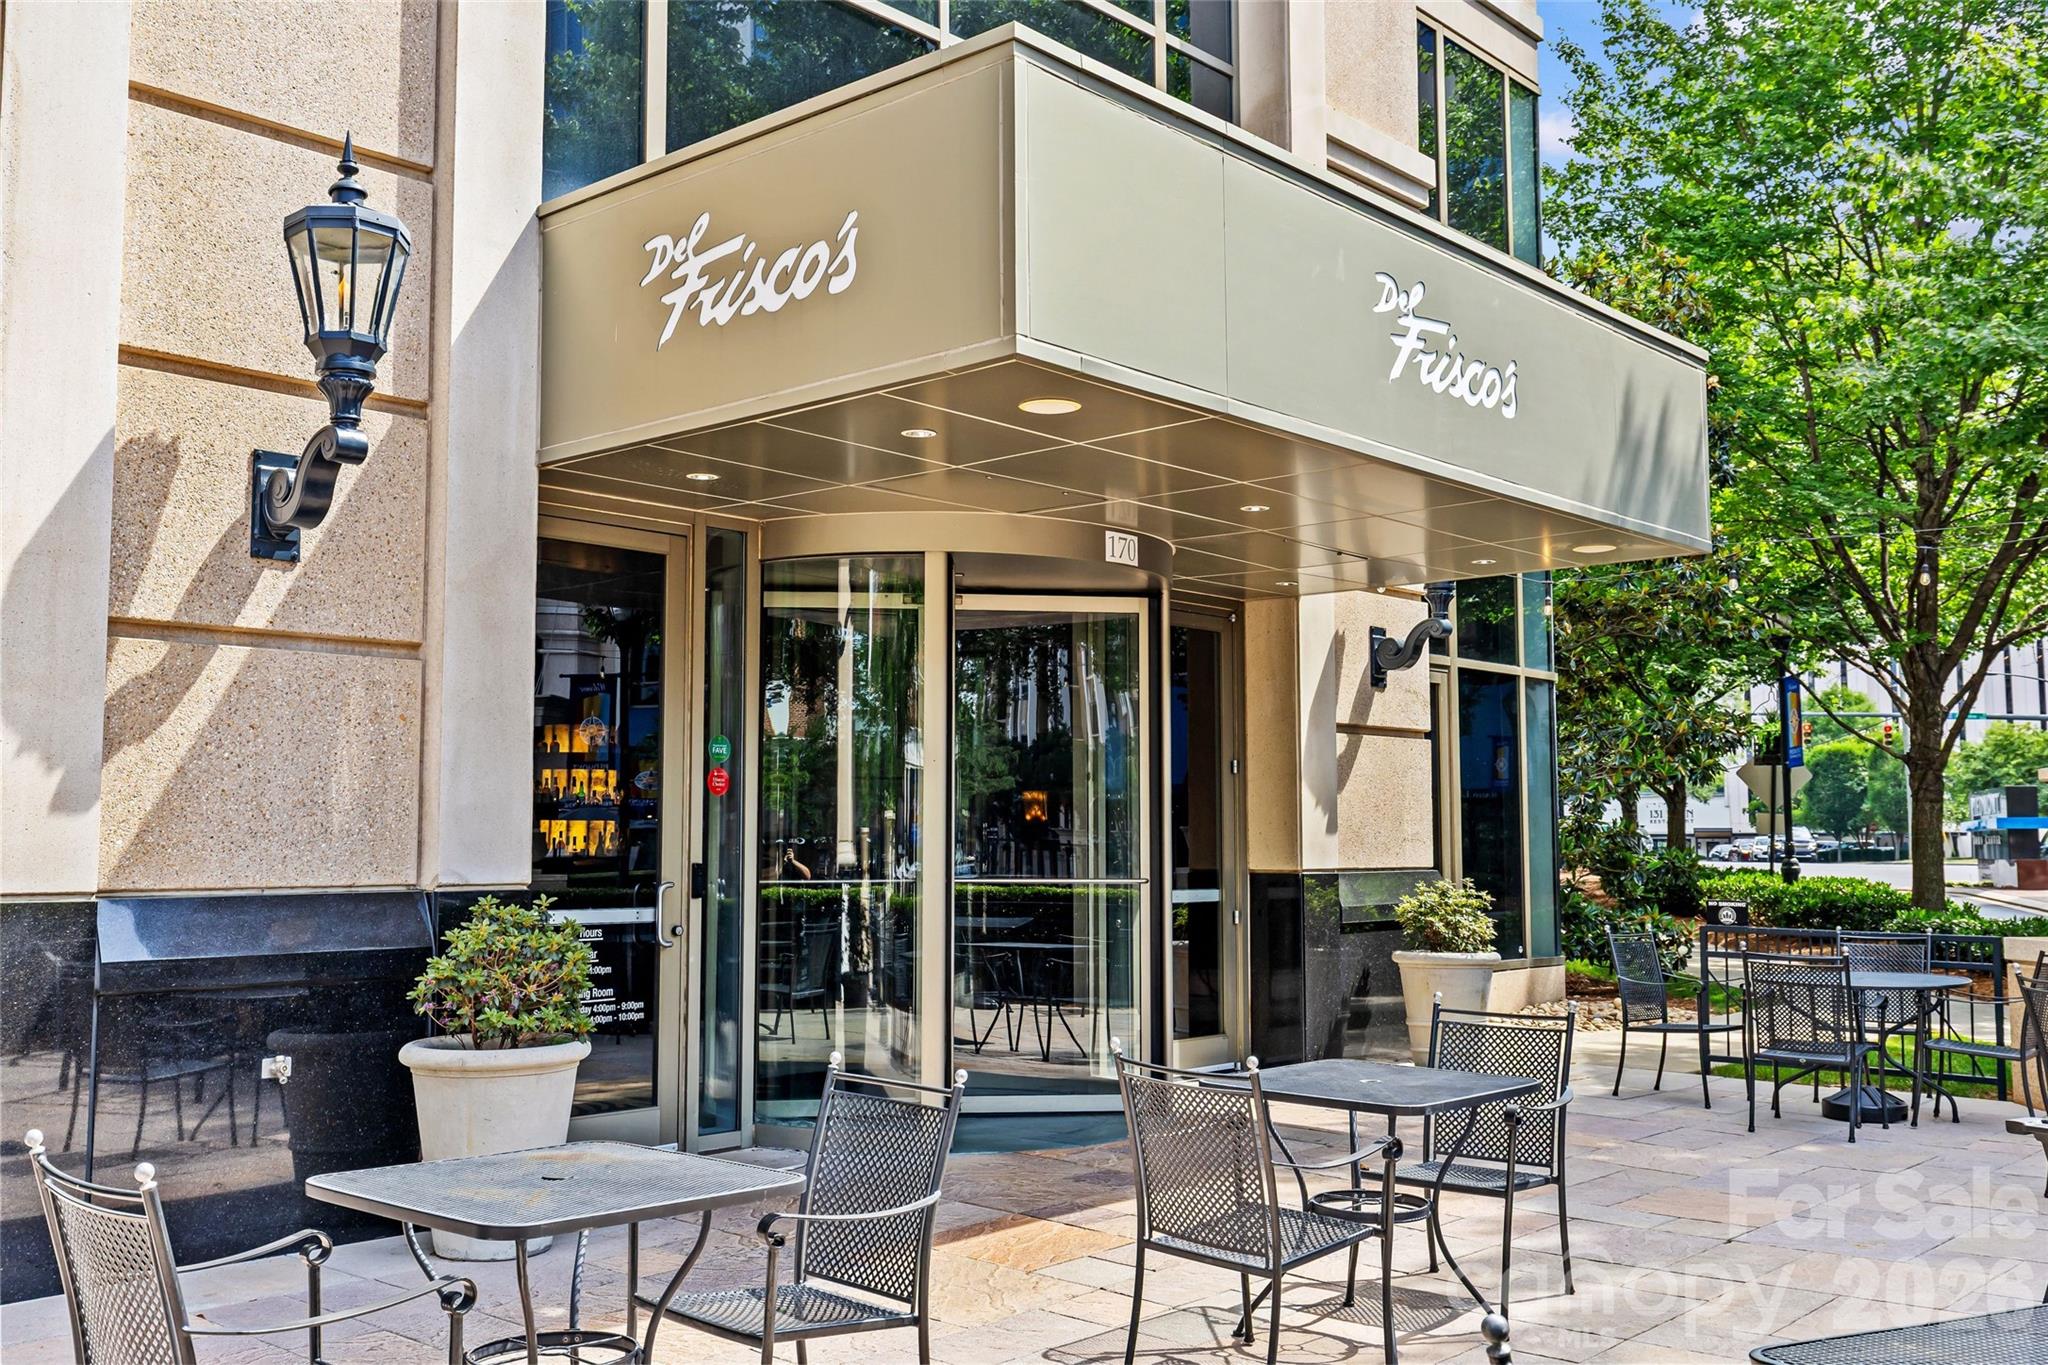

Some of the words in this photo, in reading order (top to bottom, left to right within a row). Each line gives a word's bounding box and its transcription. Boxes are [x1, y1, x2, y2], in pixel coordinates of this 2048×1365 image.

[639, 211, 710, 288] Del
[656, 209, 859, 352] Frisco's
[1372, 271, 1426, 313] Del
[1389, 313, 1518, 419] Frisco's
[1108, 535, 1136, 562] 170
[712, 746, 727, 754] FAVE
[1650, 809, 1663, 819] 131
[592, 987, 614, 998] Room
[593, 1004, 616, 1013] 4:00pm
[621, 1001, 644, 1011] 9:00pm
[618, 1012, 644, 1021] 10:00pm
